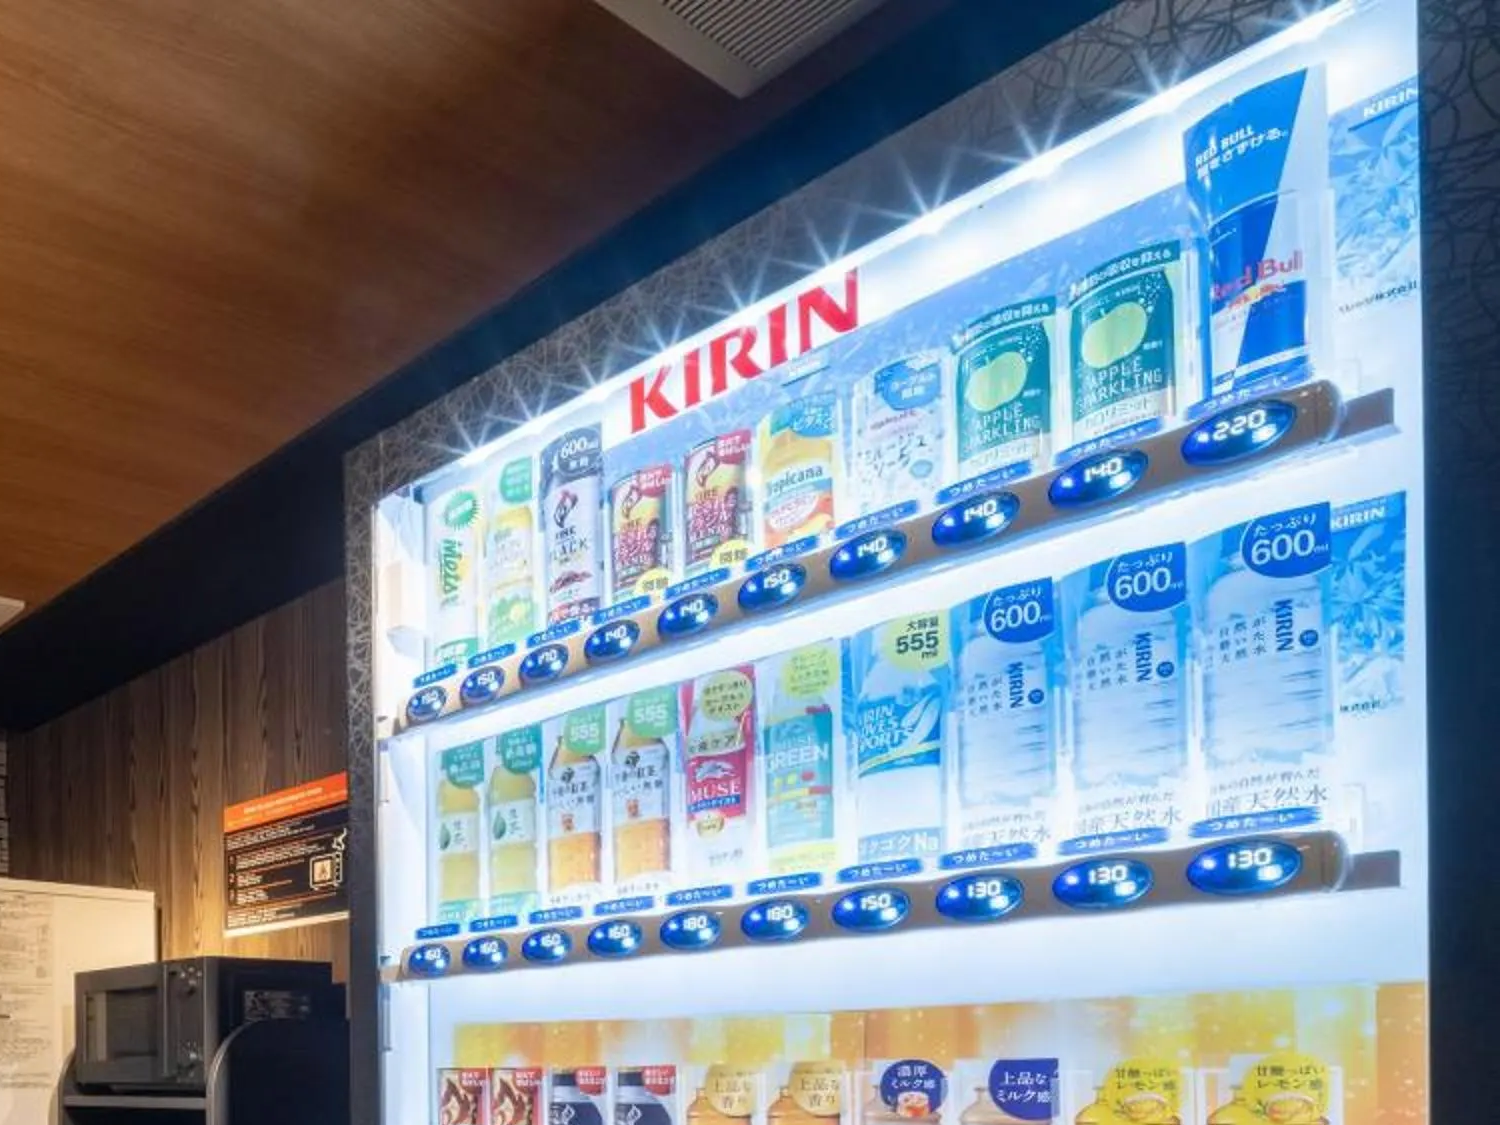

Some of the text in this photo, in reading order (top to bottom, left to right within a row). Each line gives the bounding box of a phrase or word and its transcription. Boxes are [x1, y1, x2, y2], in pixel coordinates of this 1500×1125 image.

[1221, 125, 1255, 152] BULL
[1258, 249, 1304, 280] Bull
[630, 267, 858, 434] KIRIN
[1212, 409, 1268, 441] 220
[1084, 457, 1123, 482] 140
[963, 499, 998, 523] 140
[1253, 513, 1317, 538] たっぷり
[857, 536, 888, 558] 140
[764, 568, 791, 589] 150
[1274, 598, 1295, 652] KIRIN
[895, 631, 940, 655] 555
[1134, 632, 1152, 682] KIRIN
[1008, 661, 1026, 709] KIRIN
[633, 706, 669, 724] 555
[1209, 812, 1296, 832] つめた〜い
[952, 848, 1019, 865] つめた〜い
[1227, 848, 1273, 868] 130
[1088, 865, 1128, 882] 130
[967, 880, 1001, 898] 130
[861, 892, 891, 910] 150
[1002, 1072, 1049, 1086] 上品な
[996, 1088, 1052, 1104] ミルク感
